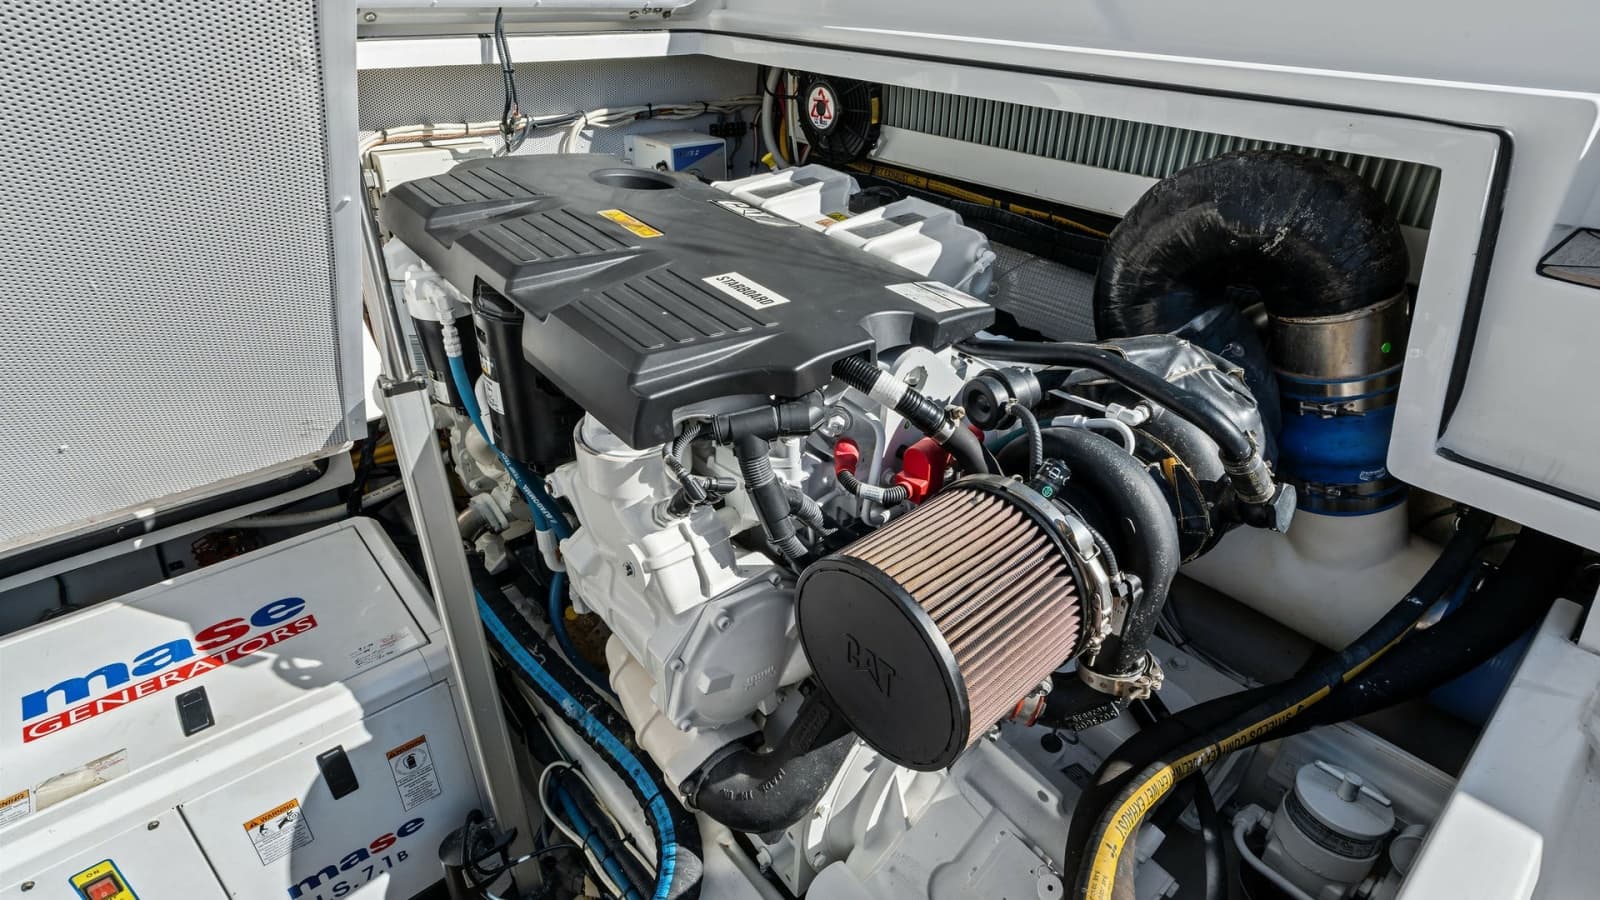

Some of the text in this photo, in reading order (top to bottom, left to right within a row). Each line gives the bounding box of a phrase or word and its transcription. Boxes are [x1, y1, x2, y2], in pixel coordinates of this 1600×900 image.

[716, 275, 775, 305] STARBOARD
[21, 597, 305, 721] mase
[27, 614, 315, 740] GENERATORS
[846, 633, 897, 697] CAT
[261, 802, 296, 823] WARNING
[1115, 797, 1147, 839] EXHAUST
[288, 817, 425, 900] mase
